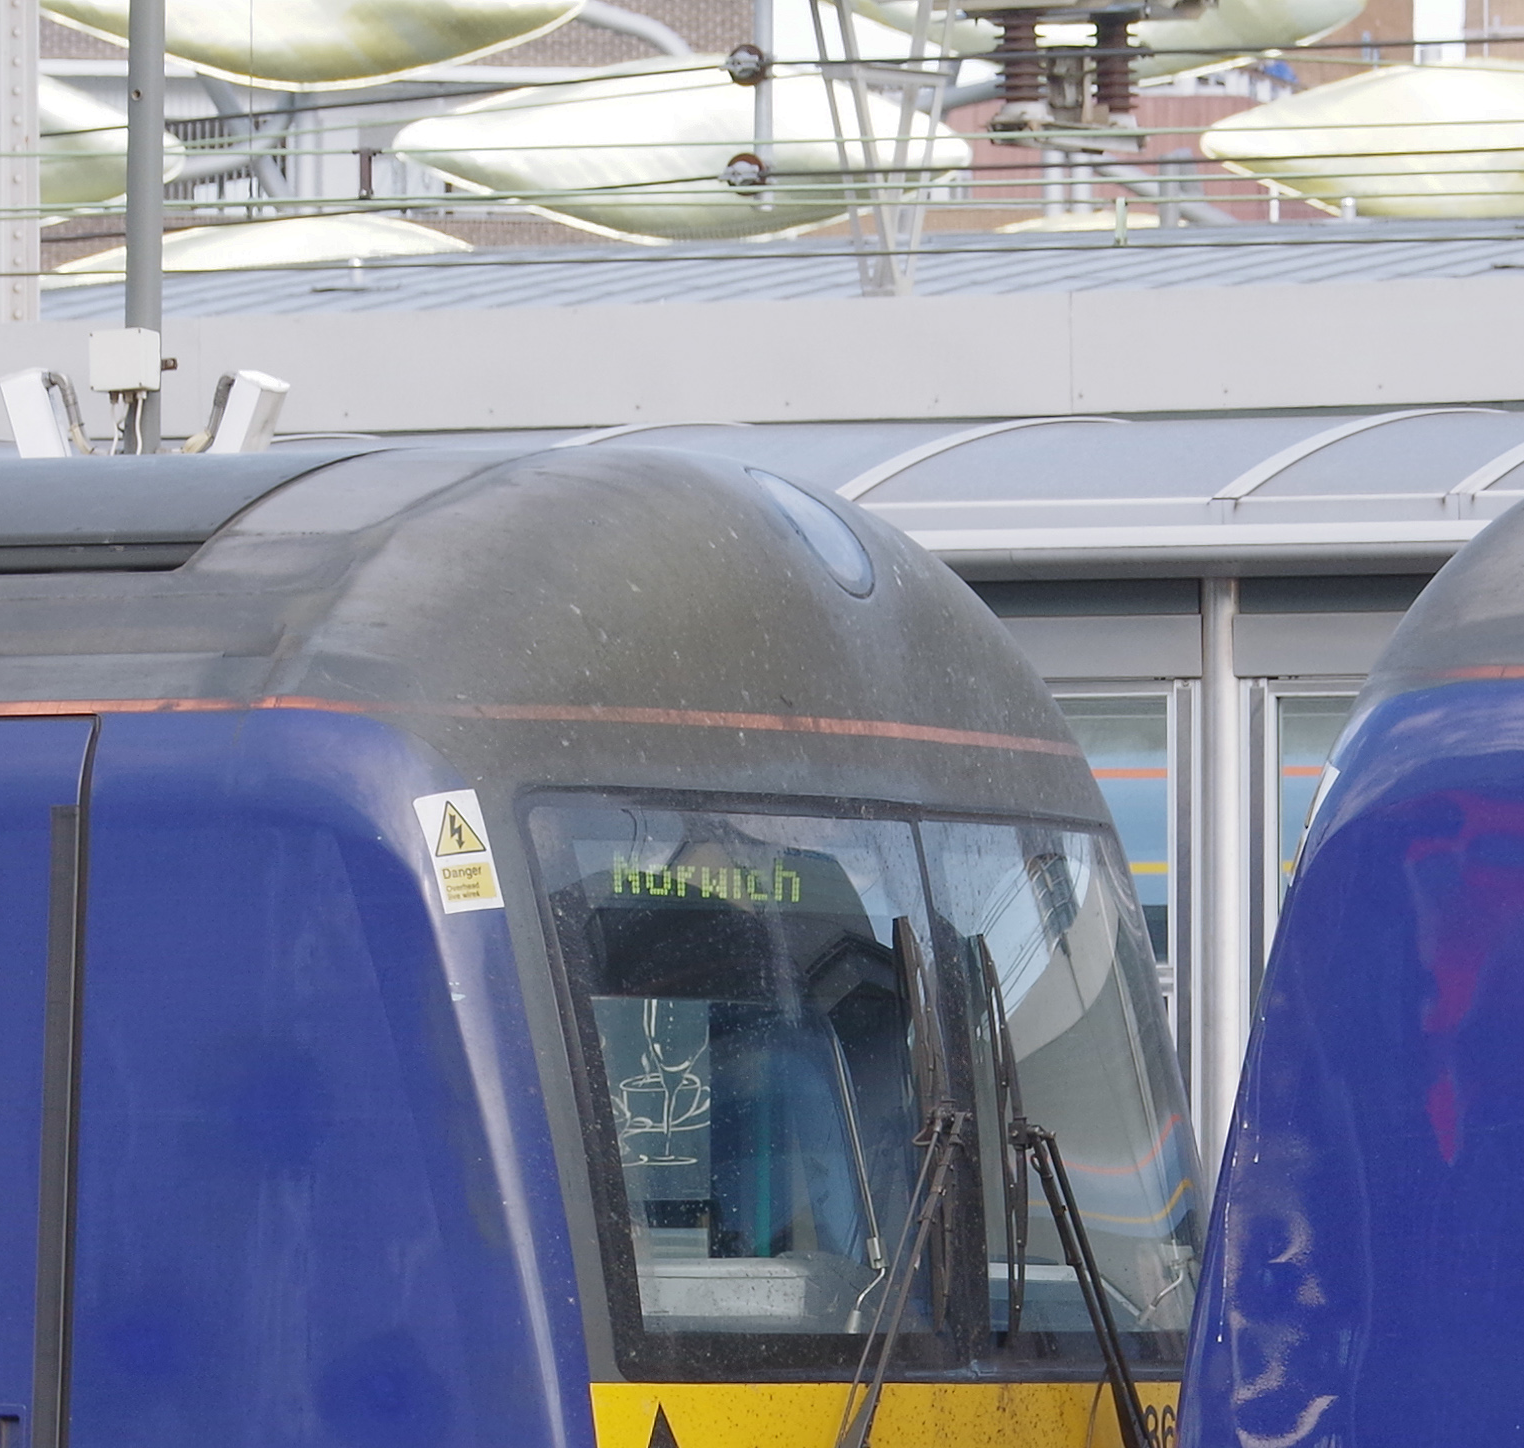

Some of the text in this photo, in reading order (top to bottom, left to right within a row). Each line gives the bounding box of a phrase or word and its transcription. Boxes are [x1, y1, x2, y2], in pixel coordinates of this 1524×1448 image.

[442, 866, 482, 880] Danger
[613, 850, 800, 902] Norwich
[446, 881, 480, 893] Overhead
